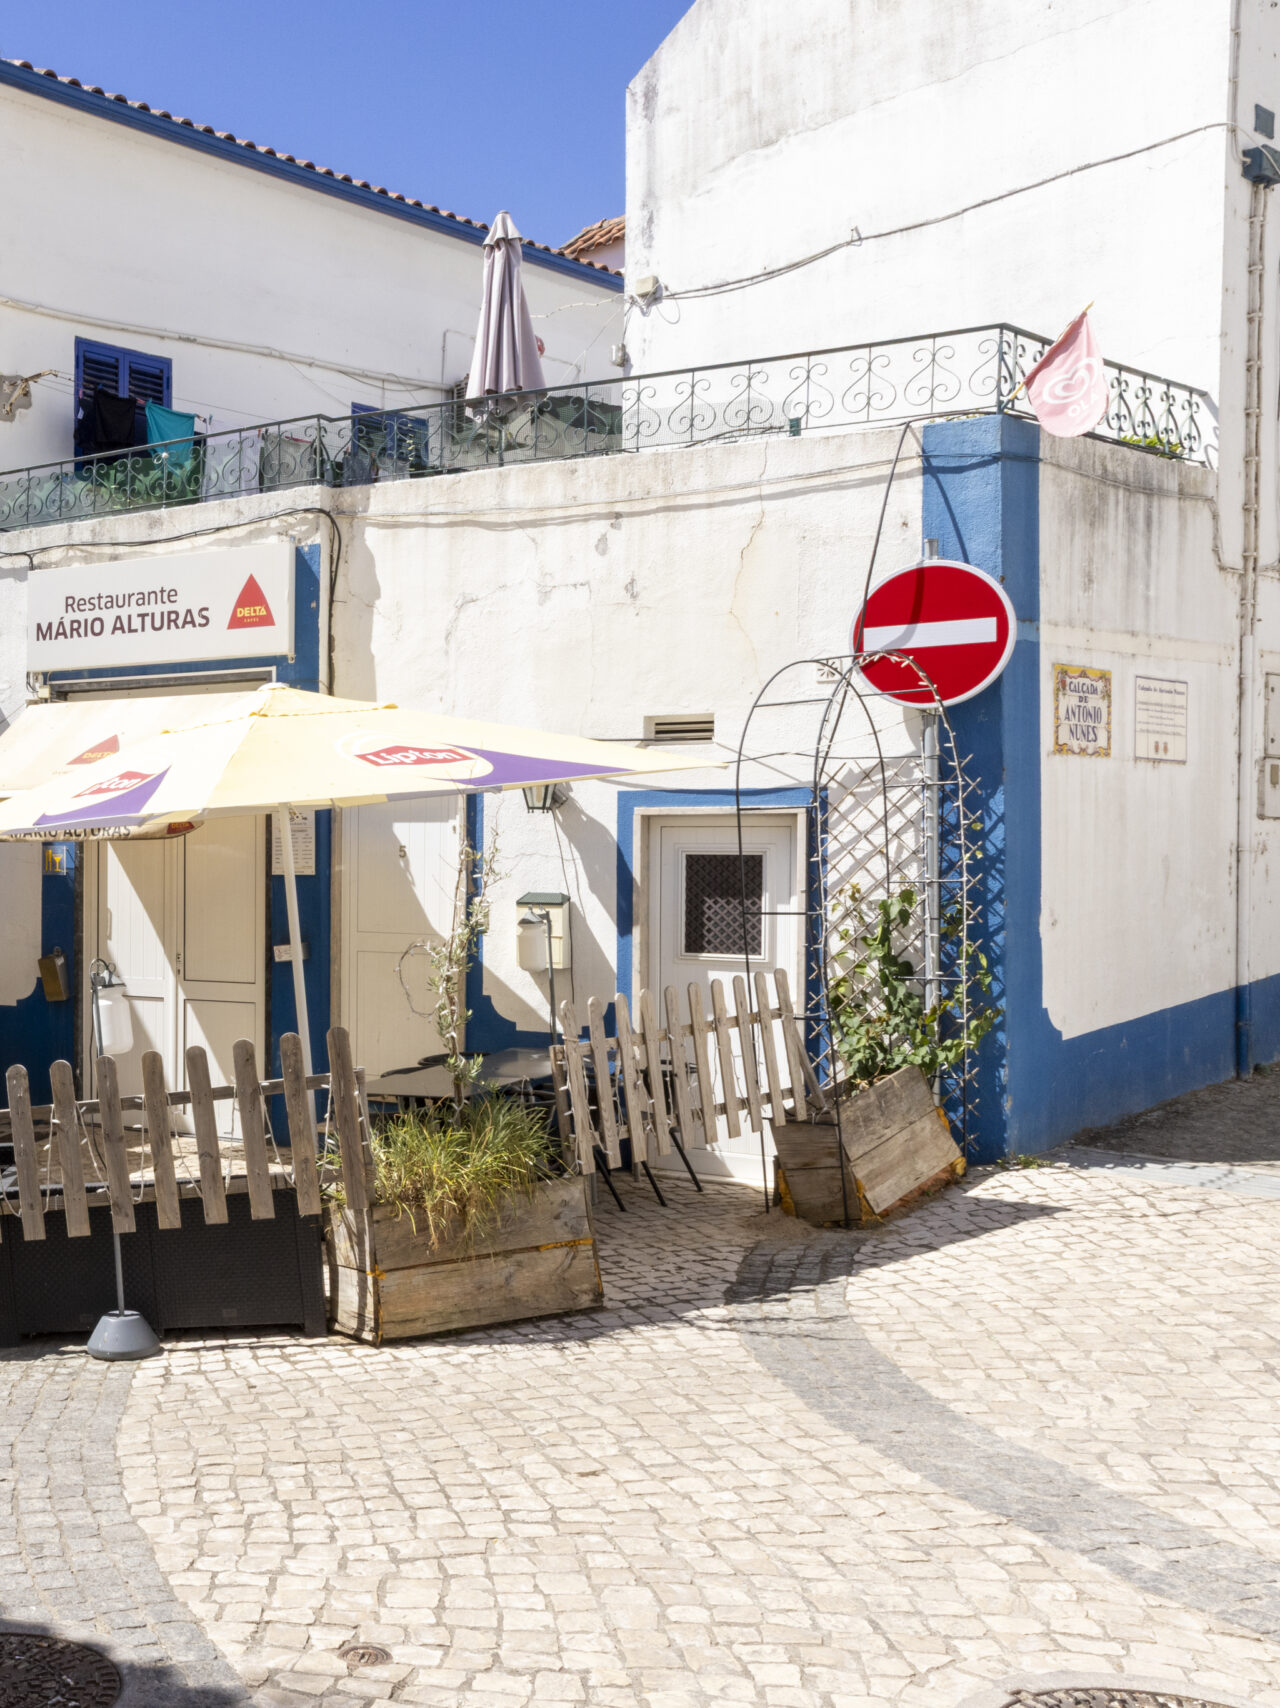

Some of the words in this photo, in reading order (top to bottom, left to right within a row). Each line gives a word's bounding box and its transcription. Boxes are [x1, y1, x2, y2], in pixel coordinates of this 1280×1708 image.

[64, 586, 179, 614] Restaurante
[236, 605, 268, 618] DELTA
[36, 617, 105, 642] MÁRIO
[111, 606, 211, 636] ALTURAS
[1068, 680, 1099, 697] CALÇADA
[1078, 695, 1089, 703] DE
[1069, 723, 1098, 743] NUNES
[365, 749, 462, 764] Lipton
[399, 844, 408, 858] 5
